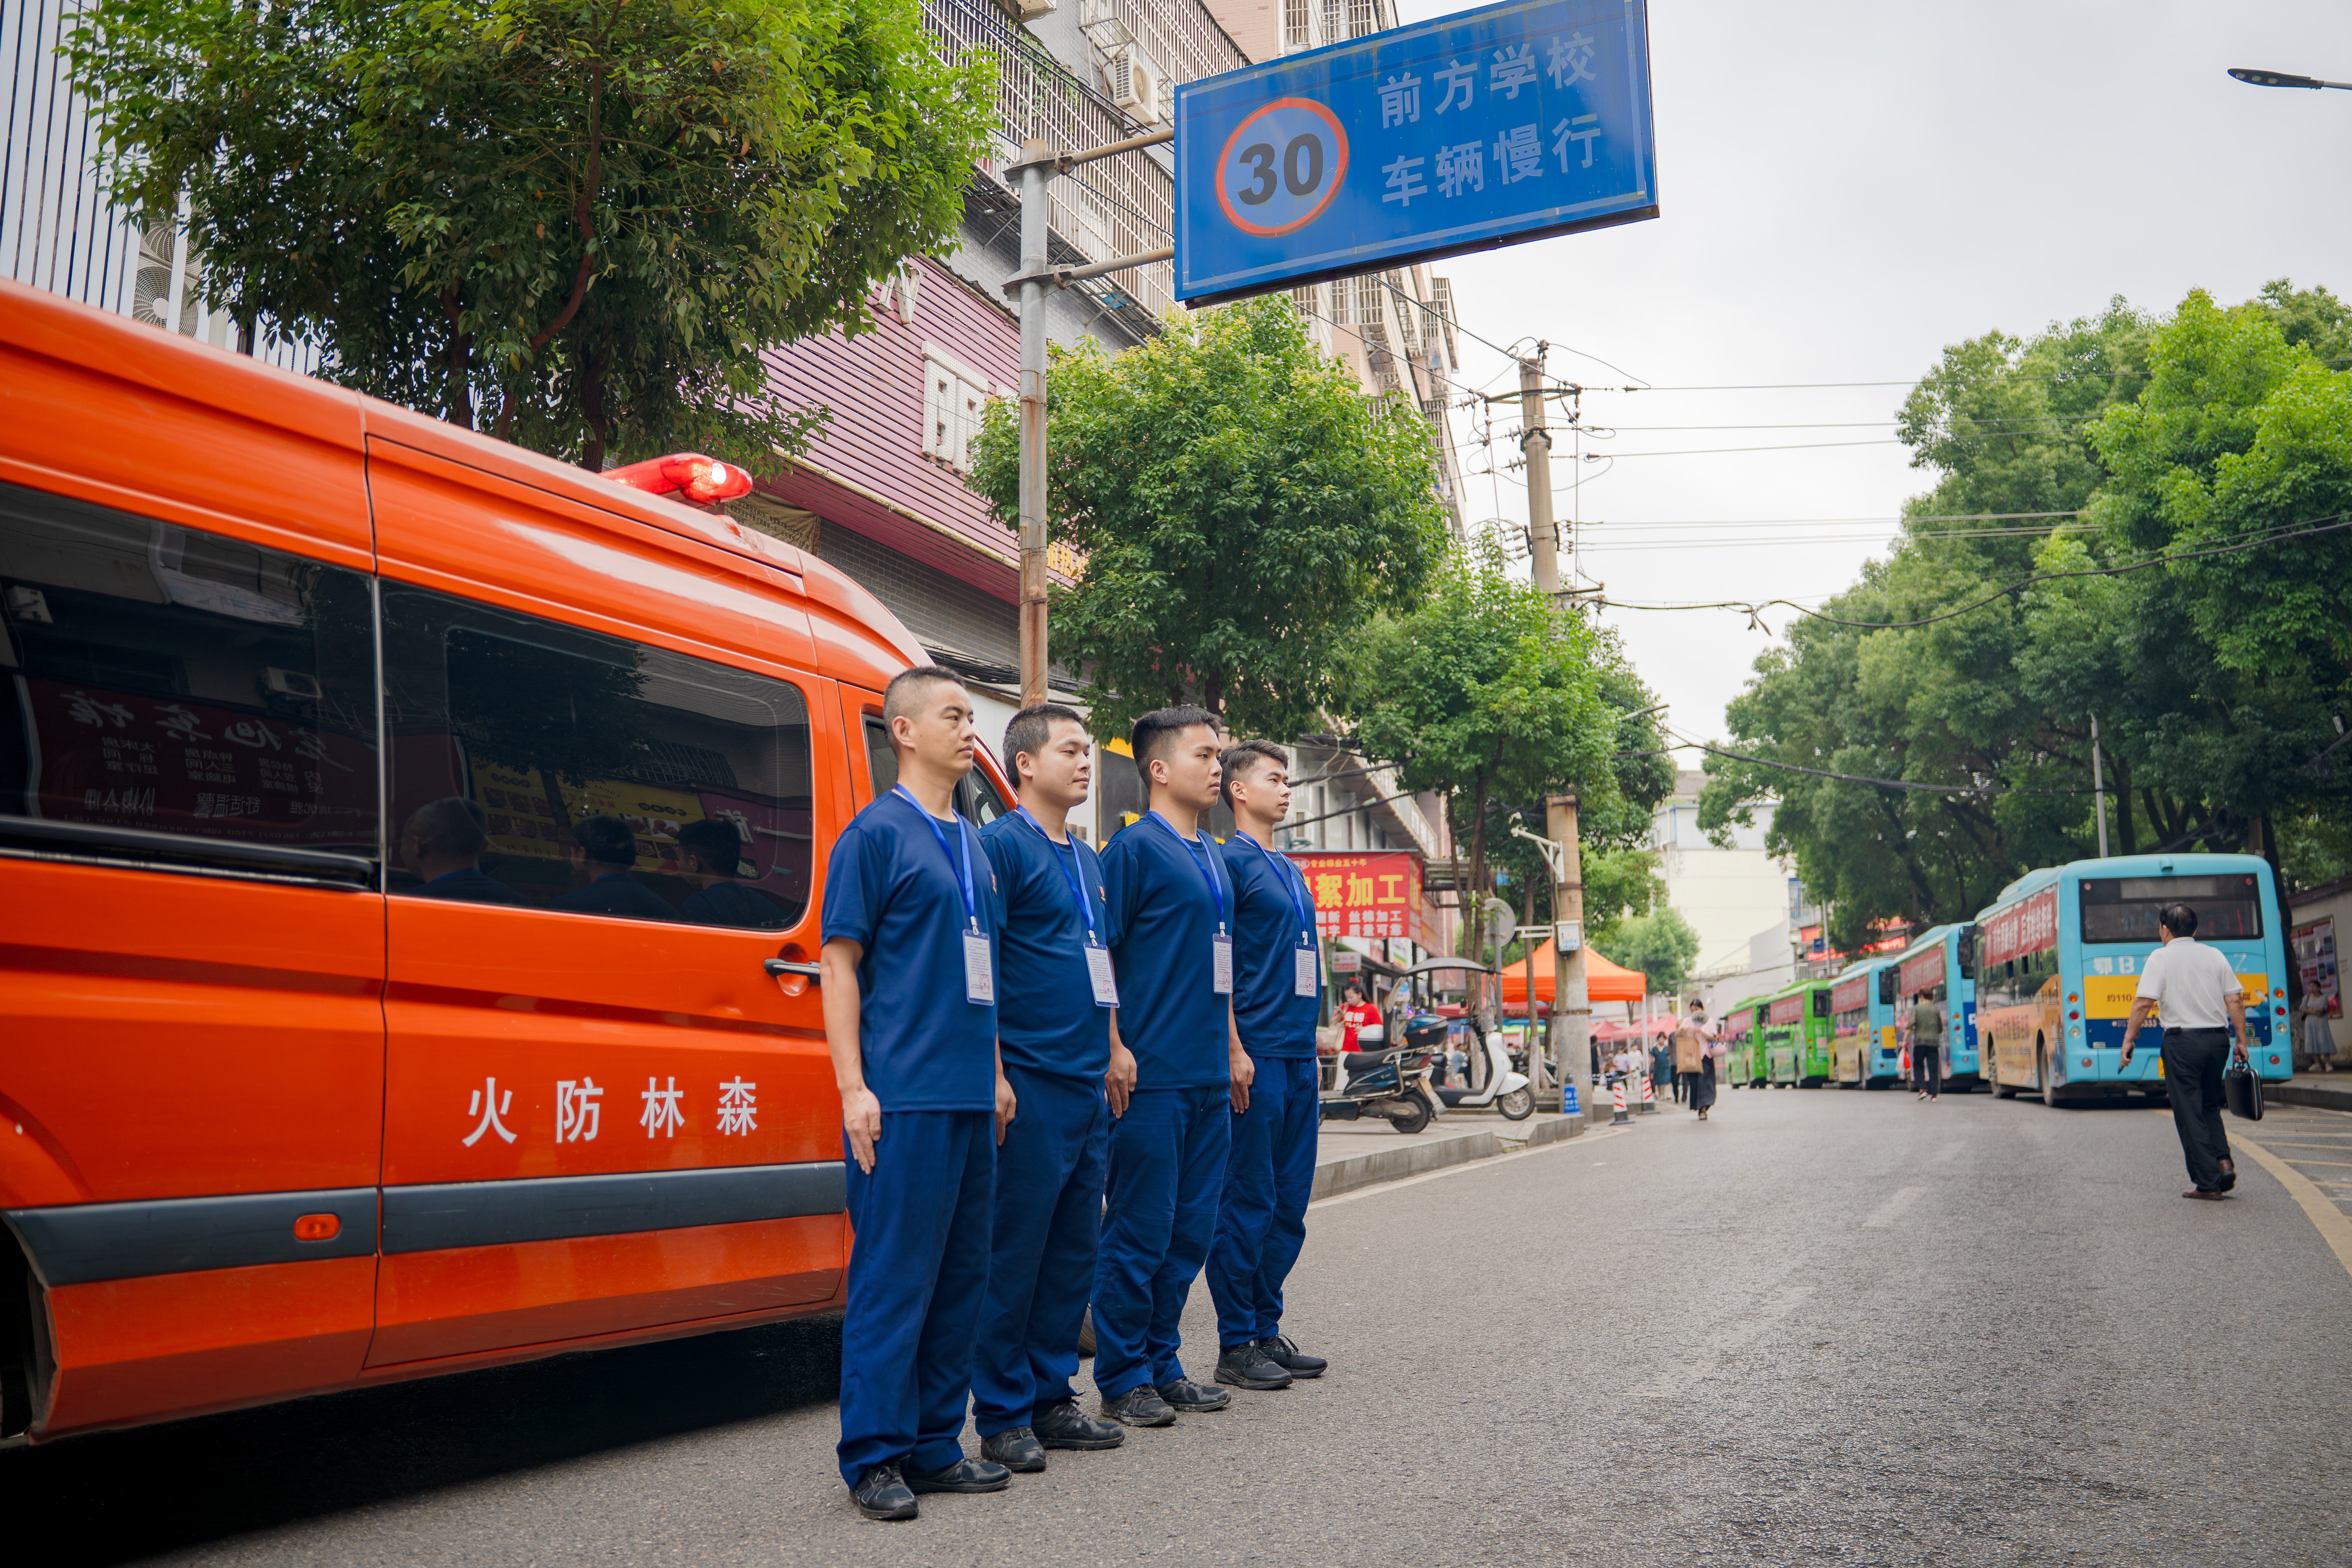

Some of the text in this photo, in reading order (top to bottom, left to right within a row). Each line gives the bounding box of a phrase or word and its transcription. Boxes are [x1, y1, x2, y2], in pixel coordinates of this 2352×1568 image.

[1378, 31, 1597, 129] 前方学校
[1238, 133, 1324, 205] 30
[1381, 113, 1601, 207] 车辆慢行
[1303, 873, 1405, 908] 絮加工
